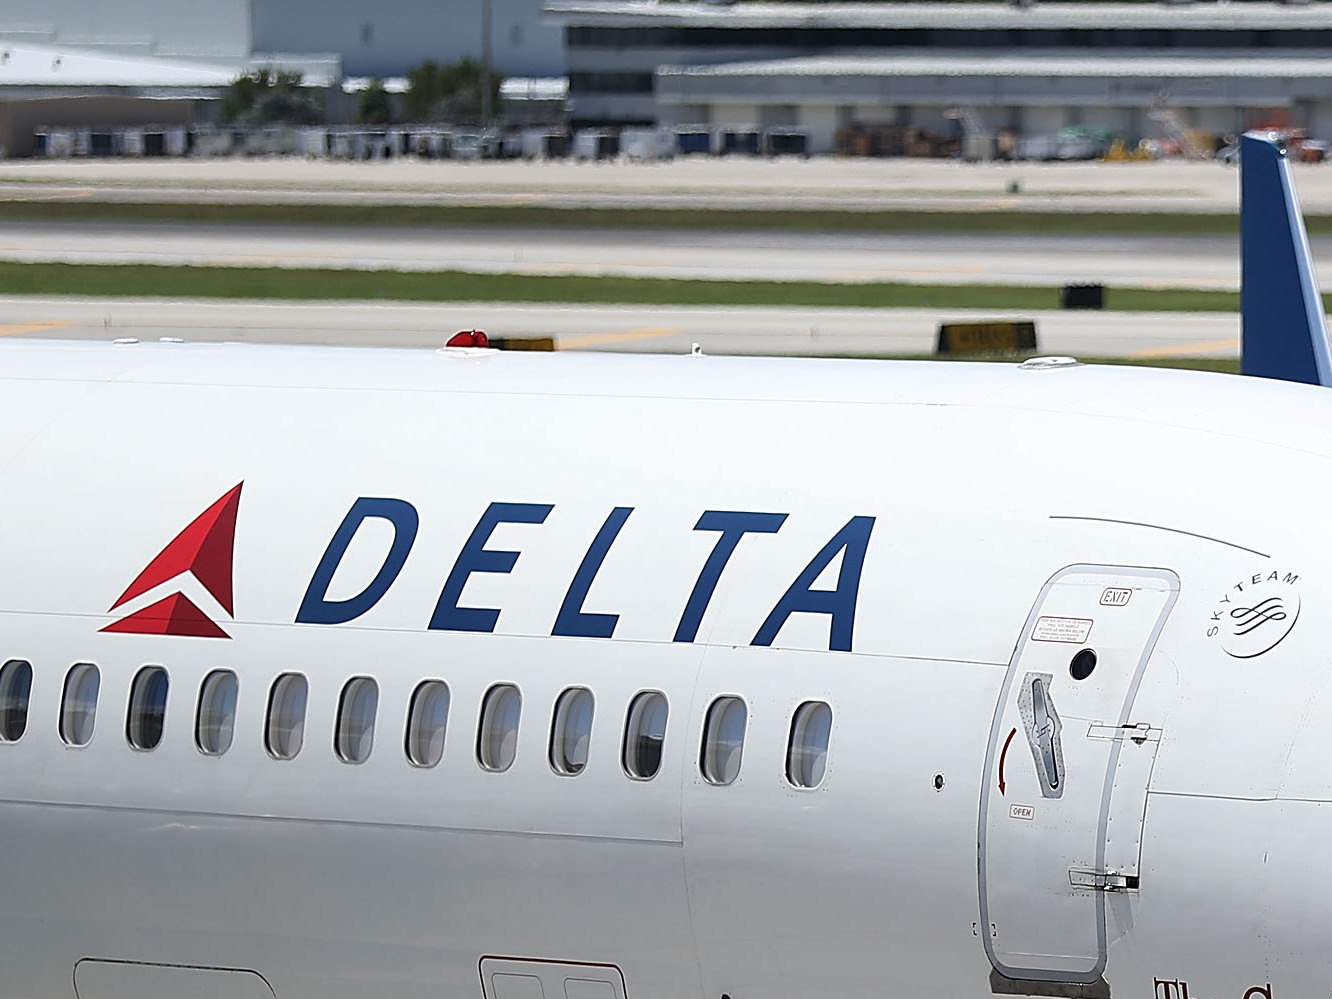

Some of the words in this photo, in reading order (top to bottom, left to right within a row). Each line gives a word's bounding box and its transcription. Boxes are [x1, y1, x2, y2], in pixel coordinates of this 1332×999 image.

[294, 497, 876, 652] DELTA
[1103, 590, 1128, 603] EXIT
[1206, 570, 1299, 637] SKYTEAM
[1013, 807, 1031, 817] OPEN
